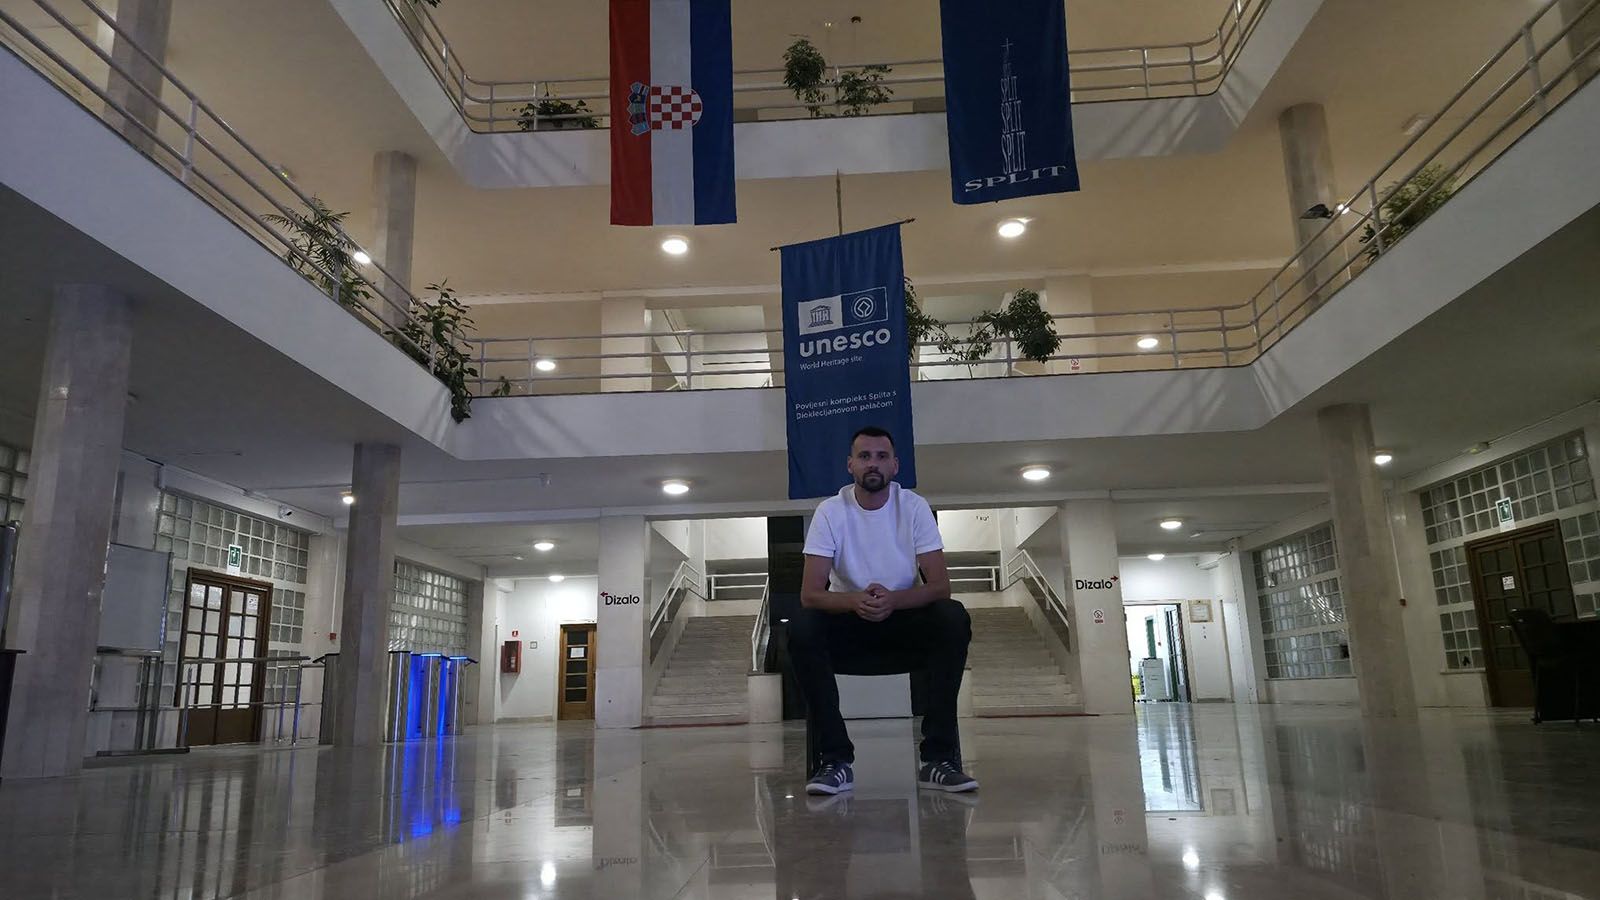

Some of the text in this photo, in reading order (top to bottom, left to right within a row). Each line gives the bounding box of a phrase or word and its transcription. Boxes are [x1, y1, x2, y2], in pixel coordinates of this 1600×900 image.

[1001, 100, 1022, 134] SPLIT
[1001, 131, 1025, 175] SPLIT
[965, 165, 1066, 192] SPLIT
[799, 328, 890, 357] unesco
[800, 355, 863, 371] World Heritage site
[795, 400, 828, 411] Povijesni
[830, 393, 866, 405] kompleks
[868, 391, 890, 401] Splita
[796, 400, 893, 420] Dioklecijanovom palačom
[1075, 579, 1113, 590] Dizalo
[605, 595, 640, 605] Dizalo
